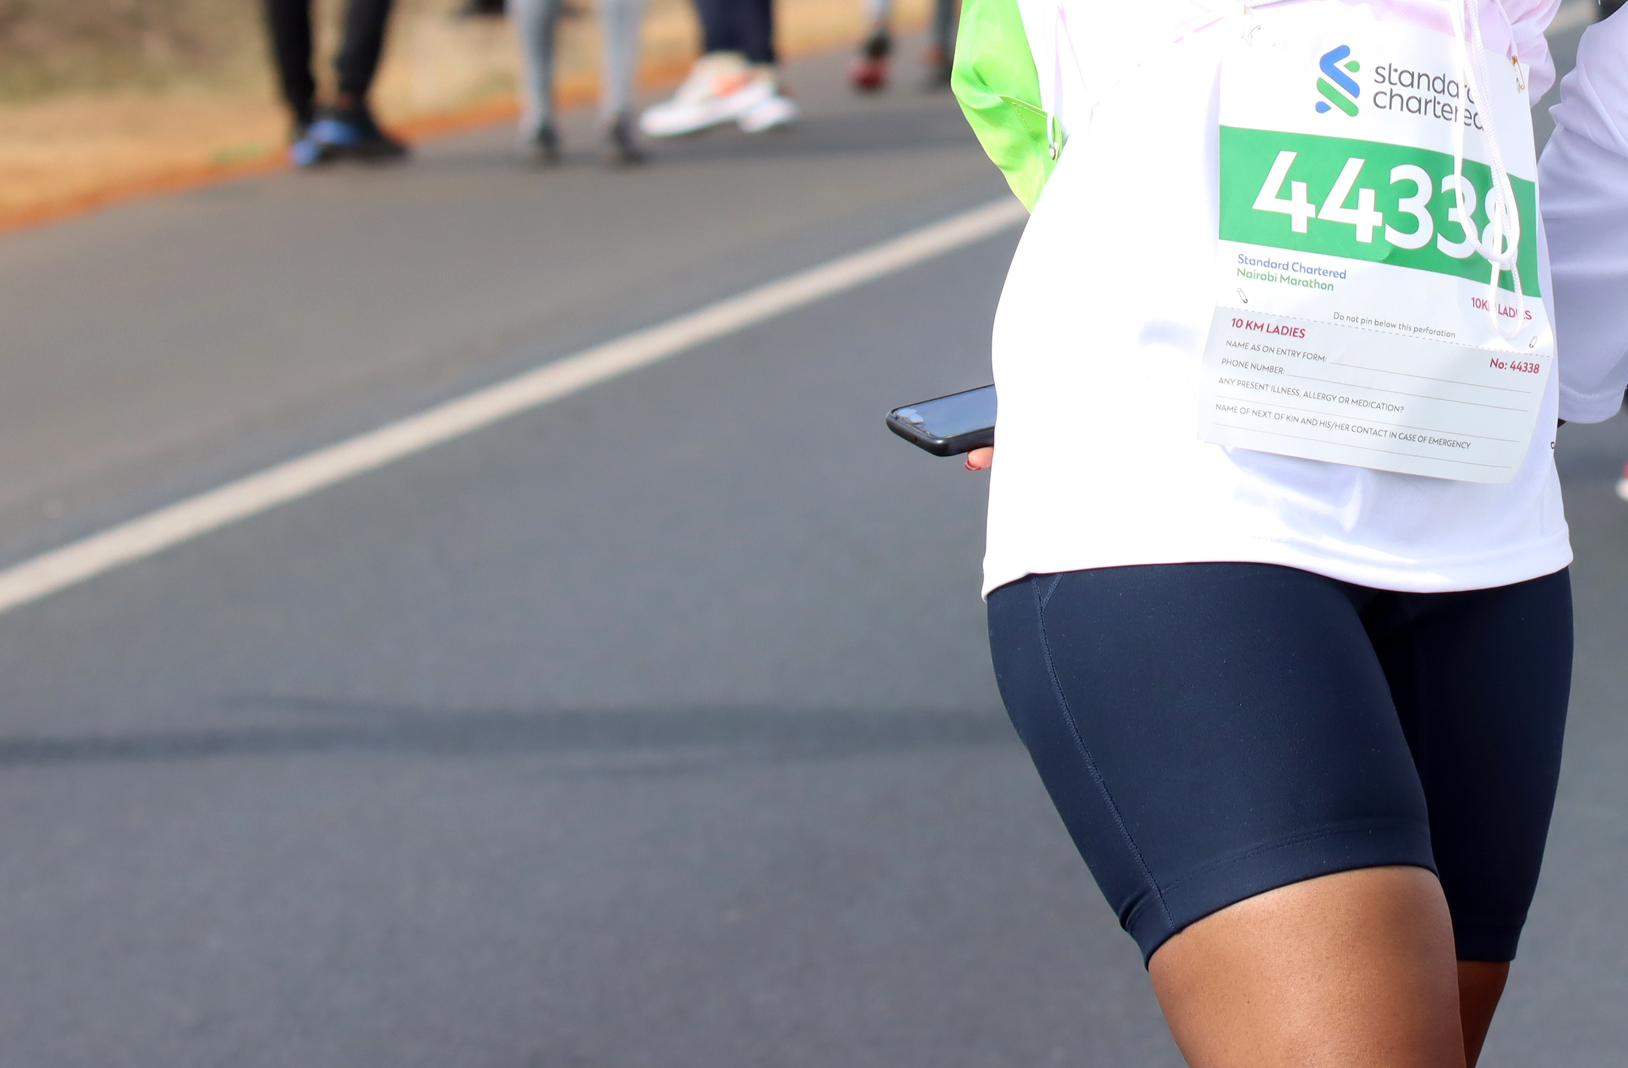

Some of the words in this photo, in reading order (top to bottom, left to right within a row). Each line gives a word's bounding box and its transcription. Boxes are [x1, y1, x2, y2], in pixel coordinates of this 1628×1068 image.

[1374, 63, 1475, 105] standa
[1252, 150, 1514, 272] 44338
[1237, 253, 1289, 270] Standard
[1291, 261, 1347, 280] Chartered
[1237, 267, 1277, 282] Nairobi
[1279, 273, 1334, 291] Marathon
[1498, 303, 1532, 320] LADIS
[1231, 318, 1243, 329] 10
[1245, 320, 1264, 332] KM
[1266, 323, 1306, 339] LADIES
[1333, 311, 1345, 321] Do
[1346, 314, 1359, 323] not
[1360, 316, 1372, 326] pin
[1374, 318, 1397, 329] below
[1398, 323, 1412, 332] this
[1413, 325, 1456, 339] perforation
[1226, 339, 1249, 350] NAME
[1250, 344, 1261, 352] AS
[1262, 345, 1275, 354] ON
[1276, 347, 1302, 358] ENTRY
[1302, 351, 1328, 363] FORM:
[1221, 357, 1249, 369] PHONE
[1250, 362, 1286, 375] NUMBER:
[1489, 358, 1508, 370] No:
[1509, 360, 1540, 374] 44338
[1218, 377, 1235, 386] ANY
[1236, 379, 1270, 392] PRESENT
[1270, 384, 1302, 398] ILLNESS,
[1302, 391, 1338, 403] ALLERGY
[1338, 396, 1350, 404] OR
[1351, 398, 1405, 413] MEDICATION?
[1215, 403, 1238, 414] NAME
[1239, 406, 1251, 415] OF
[1251, 409, 1273, 419] NEXT
[1273, 412, 1285, 421] OF
[1285, 414, 1299, 423] KIN
[1300, 417, 1318, 427] AND
[1318, 420, 1350, 432] HIS/HER
[1350, 424, 1388, 438] CONTACT
[1389, 430, 1398, 439] IN
[1398, 432, 1417, 442] CASE
[1417, 435, 1428, 443] OF
[1428, 436, 1472, 450] EMERGENCY
